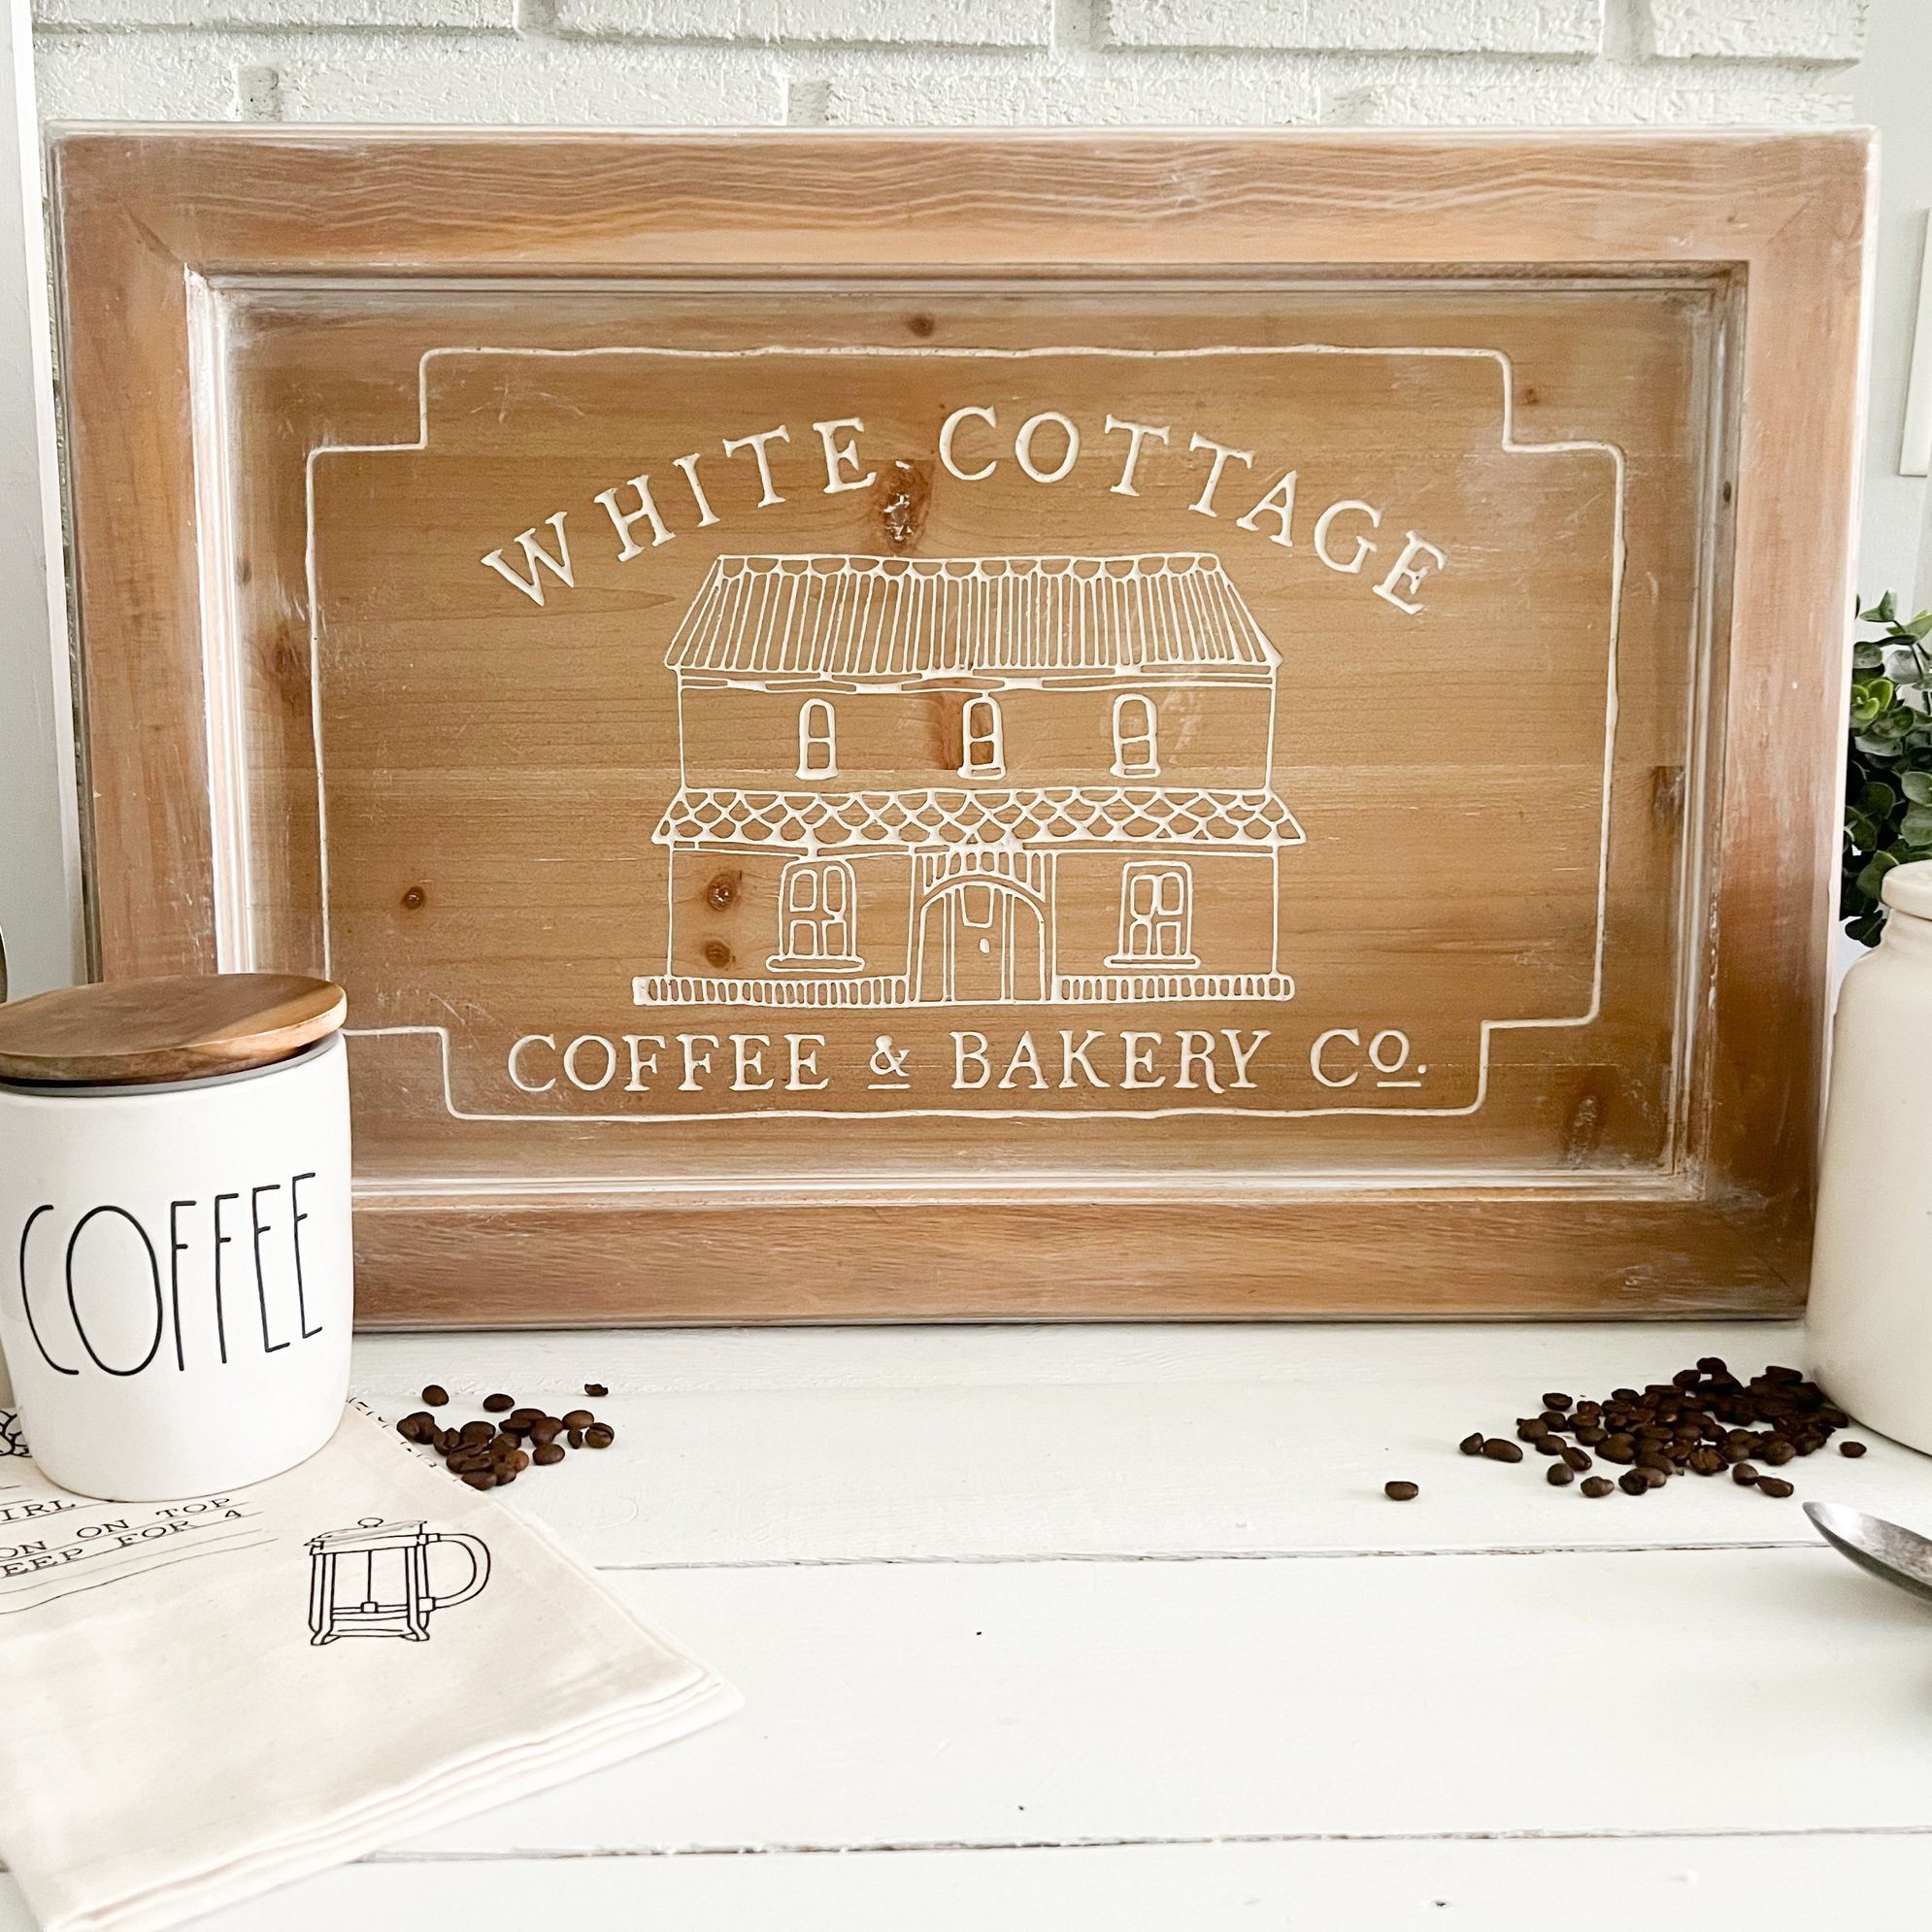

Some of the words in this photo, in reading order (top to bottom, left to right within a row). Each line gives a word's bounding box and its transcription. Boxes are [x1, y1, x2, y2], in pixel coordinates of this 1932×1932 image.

[481, 417, 877, 607] WHITE
[939, 405, 1448, 615] COTTAGE
[508, 1033, 830, 1093] COFFEE
[867, 1035, 911, 1090] &
[949, 1028, 1272, 1093] BAKERY
[19, 1172, 323, 1377] COFFEE
[76, 1518, 129, 1539] ON
[154, 1497, 230, 1518] TOP
[113, 1520, 197, 1549] FOR
